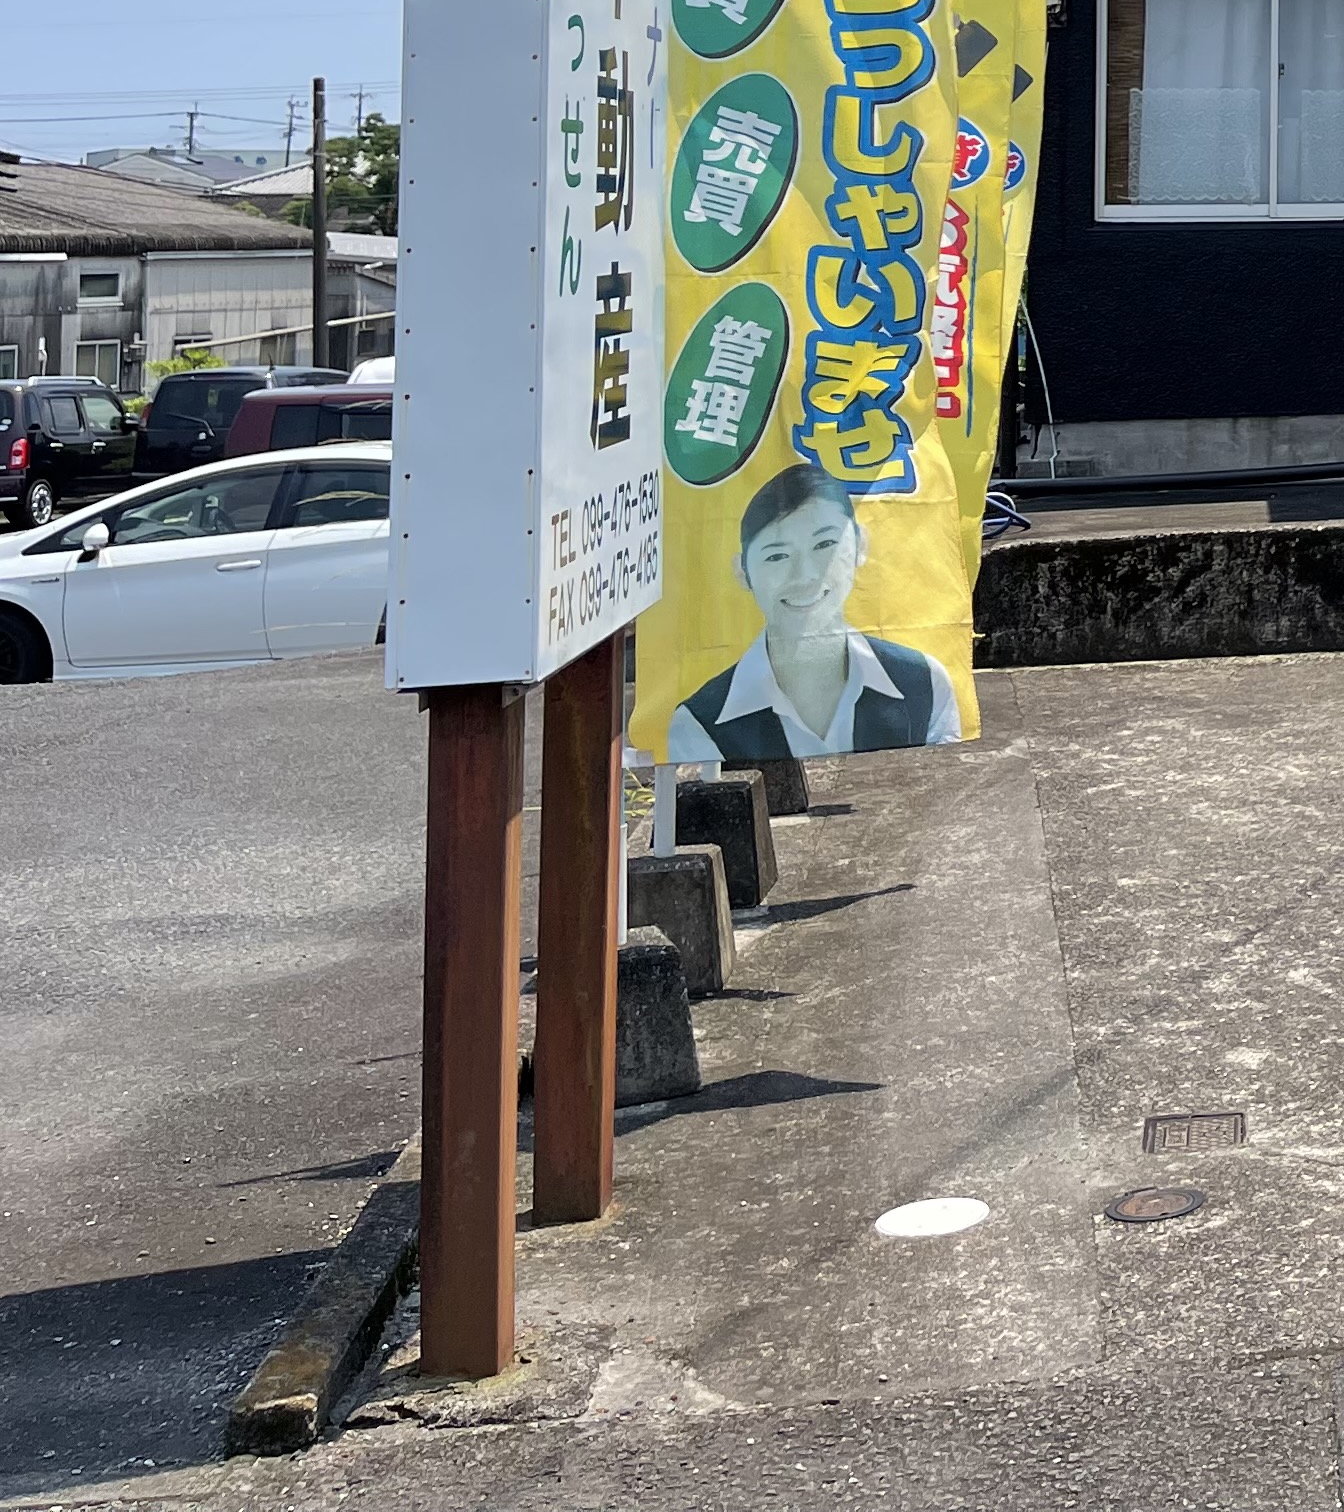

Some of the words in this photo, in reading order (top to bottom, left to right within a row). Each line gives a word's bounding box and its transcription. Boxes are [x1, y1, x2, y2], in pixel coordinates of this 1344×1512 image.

[683, 105, 782, 237] 売買
[675, 315, 773, 448] 管理
[550, 508, 577, 571] TEL
[581, 468, 660, 556] 099-476-1530
[548, 577, 575, 646] FAX
[579, 530, 659, 627] 099-476-4185
